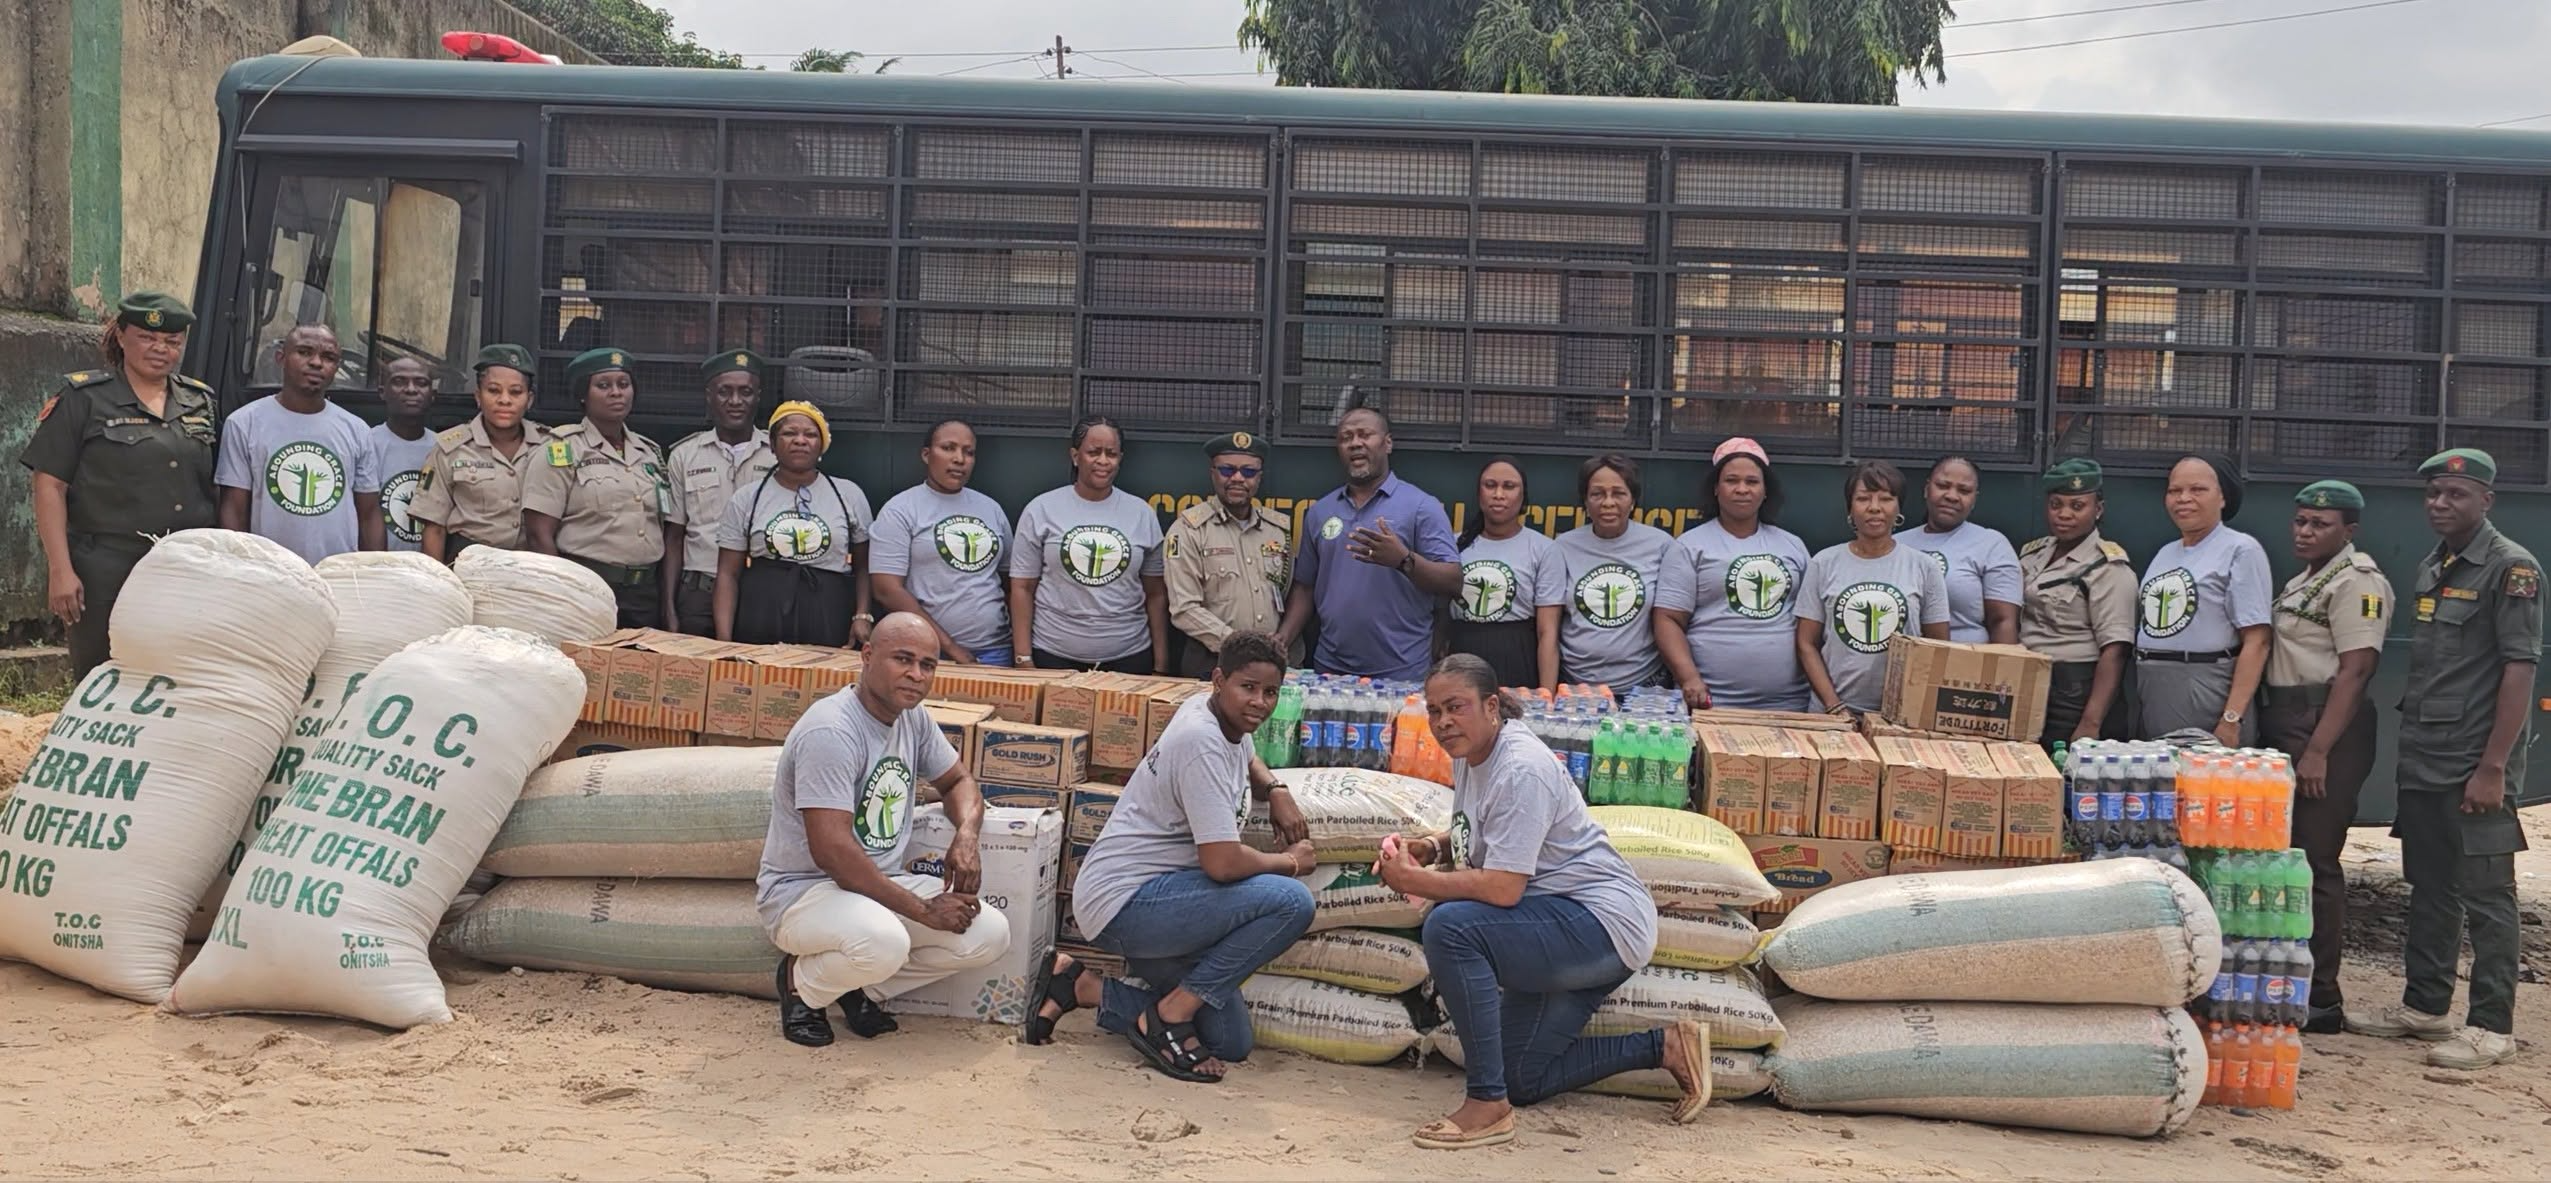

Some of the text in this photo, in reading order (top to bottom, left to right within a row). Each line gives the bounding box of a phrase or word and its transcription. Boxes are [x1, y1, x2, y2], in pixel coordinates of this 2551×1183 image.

[269, 444, 343, 488] ABOUNDING GRACE
[382, 472, 420, 509] ABOUNDIN
[280, 498, 337, 515] FOUNDATION
[1070, 569, 1122, 587] FOUNDATION
[1576, 565, 1644, 598] ABOUNDING GRACE
[1835, 583, 1907, 620] ABOUNDING GRACE
[1588, 606, 1639, 628] FOUNDATION
[1848, 638, 1890, 653] FOUNDAT
[82, 721, 144, 748] SACK
[1939, 715, 2007, 736] FORTITUDE
[991, 748, 1047, 762] GOLD RUSH
[33, 747, 151, 801] BRAN
[383, 754, 446, 791] SACK
[326, 778, 447, 846] BRAN
[1082, 806, 1107, 819] GOLD
[1326, 815, 1375, 826] Parboiled
[1377, 816, 1399, 826] Rice
[23, 803, 133, 851] OFFALS
[311, 832, 420, 888] OFFALS
[1616, 844, 1658, 856] arboiled
[1661, 846, 1682, 855] Rice
[13, 854, 56, 898] KG
[246, 865, 344, 918] 100 KG
[1651, 883, 1699, 896] Tradition
[1315, 895, 1362, 910] Parboiled
[1364, 894, 1385, 905] Rice
[1657, 909, 1705, 924] Parboiled
[1707, 916, 1730, 928] Rice
[53, 933, 104, 950] ONITSHA
[1320, 933, 1364, 947] Parboiled
[1366, 938, 1386, 950] Rice
[339, 953, 390, 969] ONITSHA
[1257, 1000, 1283, 1013] Grain
[1382, 1020, 1402, 1030] Rice
[1619, 997, 1667, 1009] Premium
[1670, 1001, 1720, 1015] Parboiled
[1723, 1007, 1745, 1018] Rice
[1747, 1009, 1774, 1024] 50Kg
